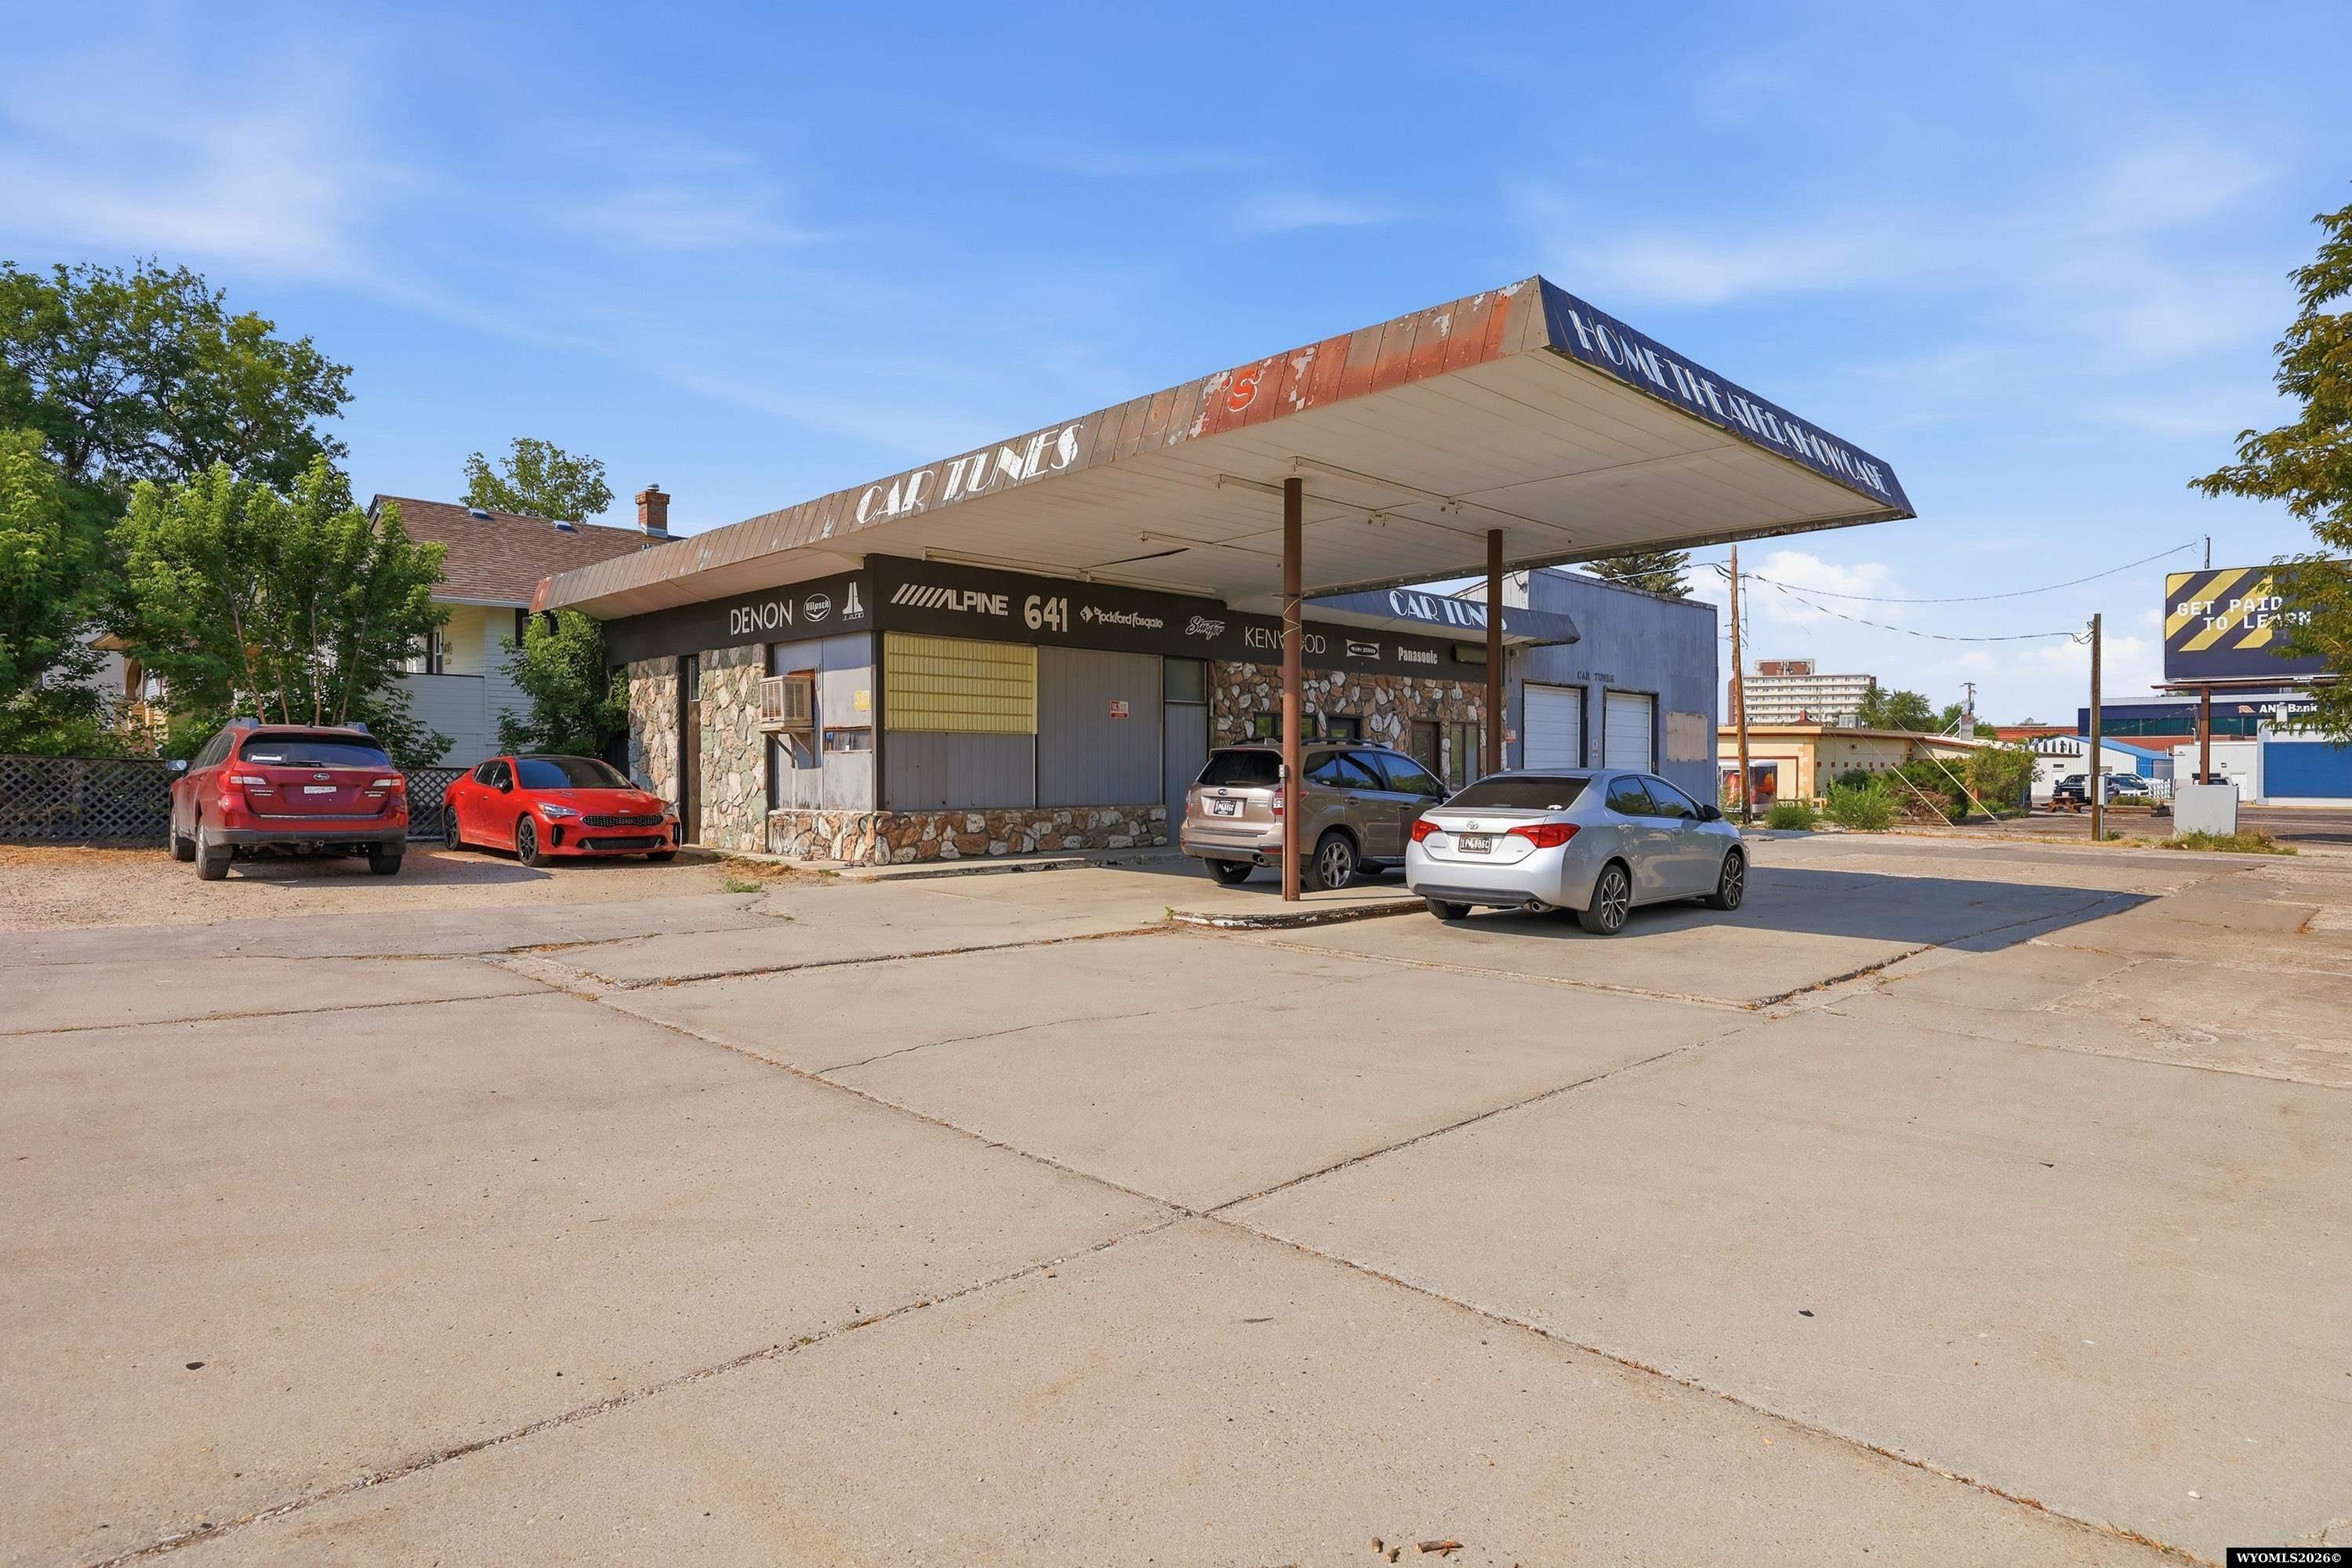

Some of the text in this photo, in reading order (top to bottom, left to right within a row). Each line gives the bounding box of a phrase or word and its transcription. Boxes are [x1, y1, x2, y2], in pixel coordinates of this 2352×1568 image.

[1568, 309, 1891, 496] HOME THEATER SHOWCASE
[856, 423, 1083, 524] CAR TUNES
[934, 589, 1009, 615] ALPINE
[1024, 594, 1068, 633] 641
[1389, 590, 1508, 630] CAR TUN
[2177, 596, 2283, 616] GET PAID
[731, 599, 793, 636] DENON
[2203, 616, 2228, 630] TO
[1244, 626, 1327, 654] KENOD
[1398, 646, 1438, 665] Panasonic
[1577, 670, 1590, 681] CAR
[2259, 702, 2281, 713] AN
